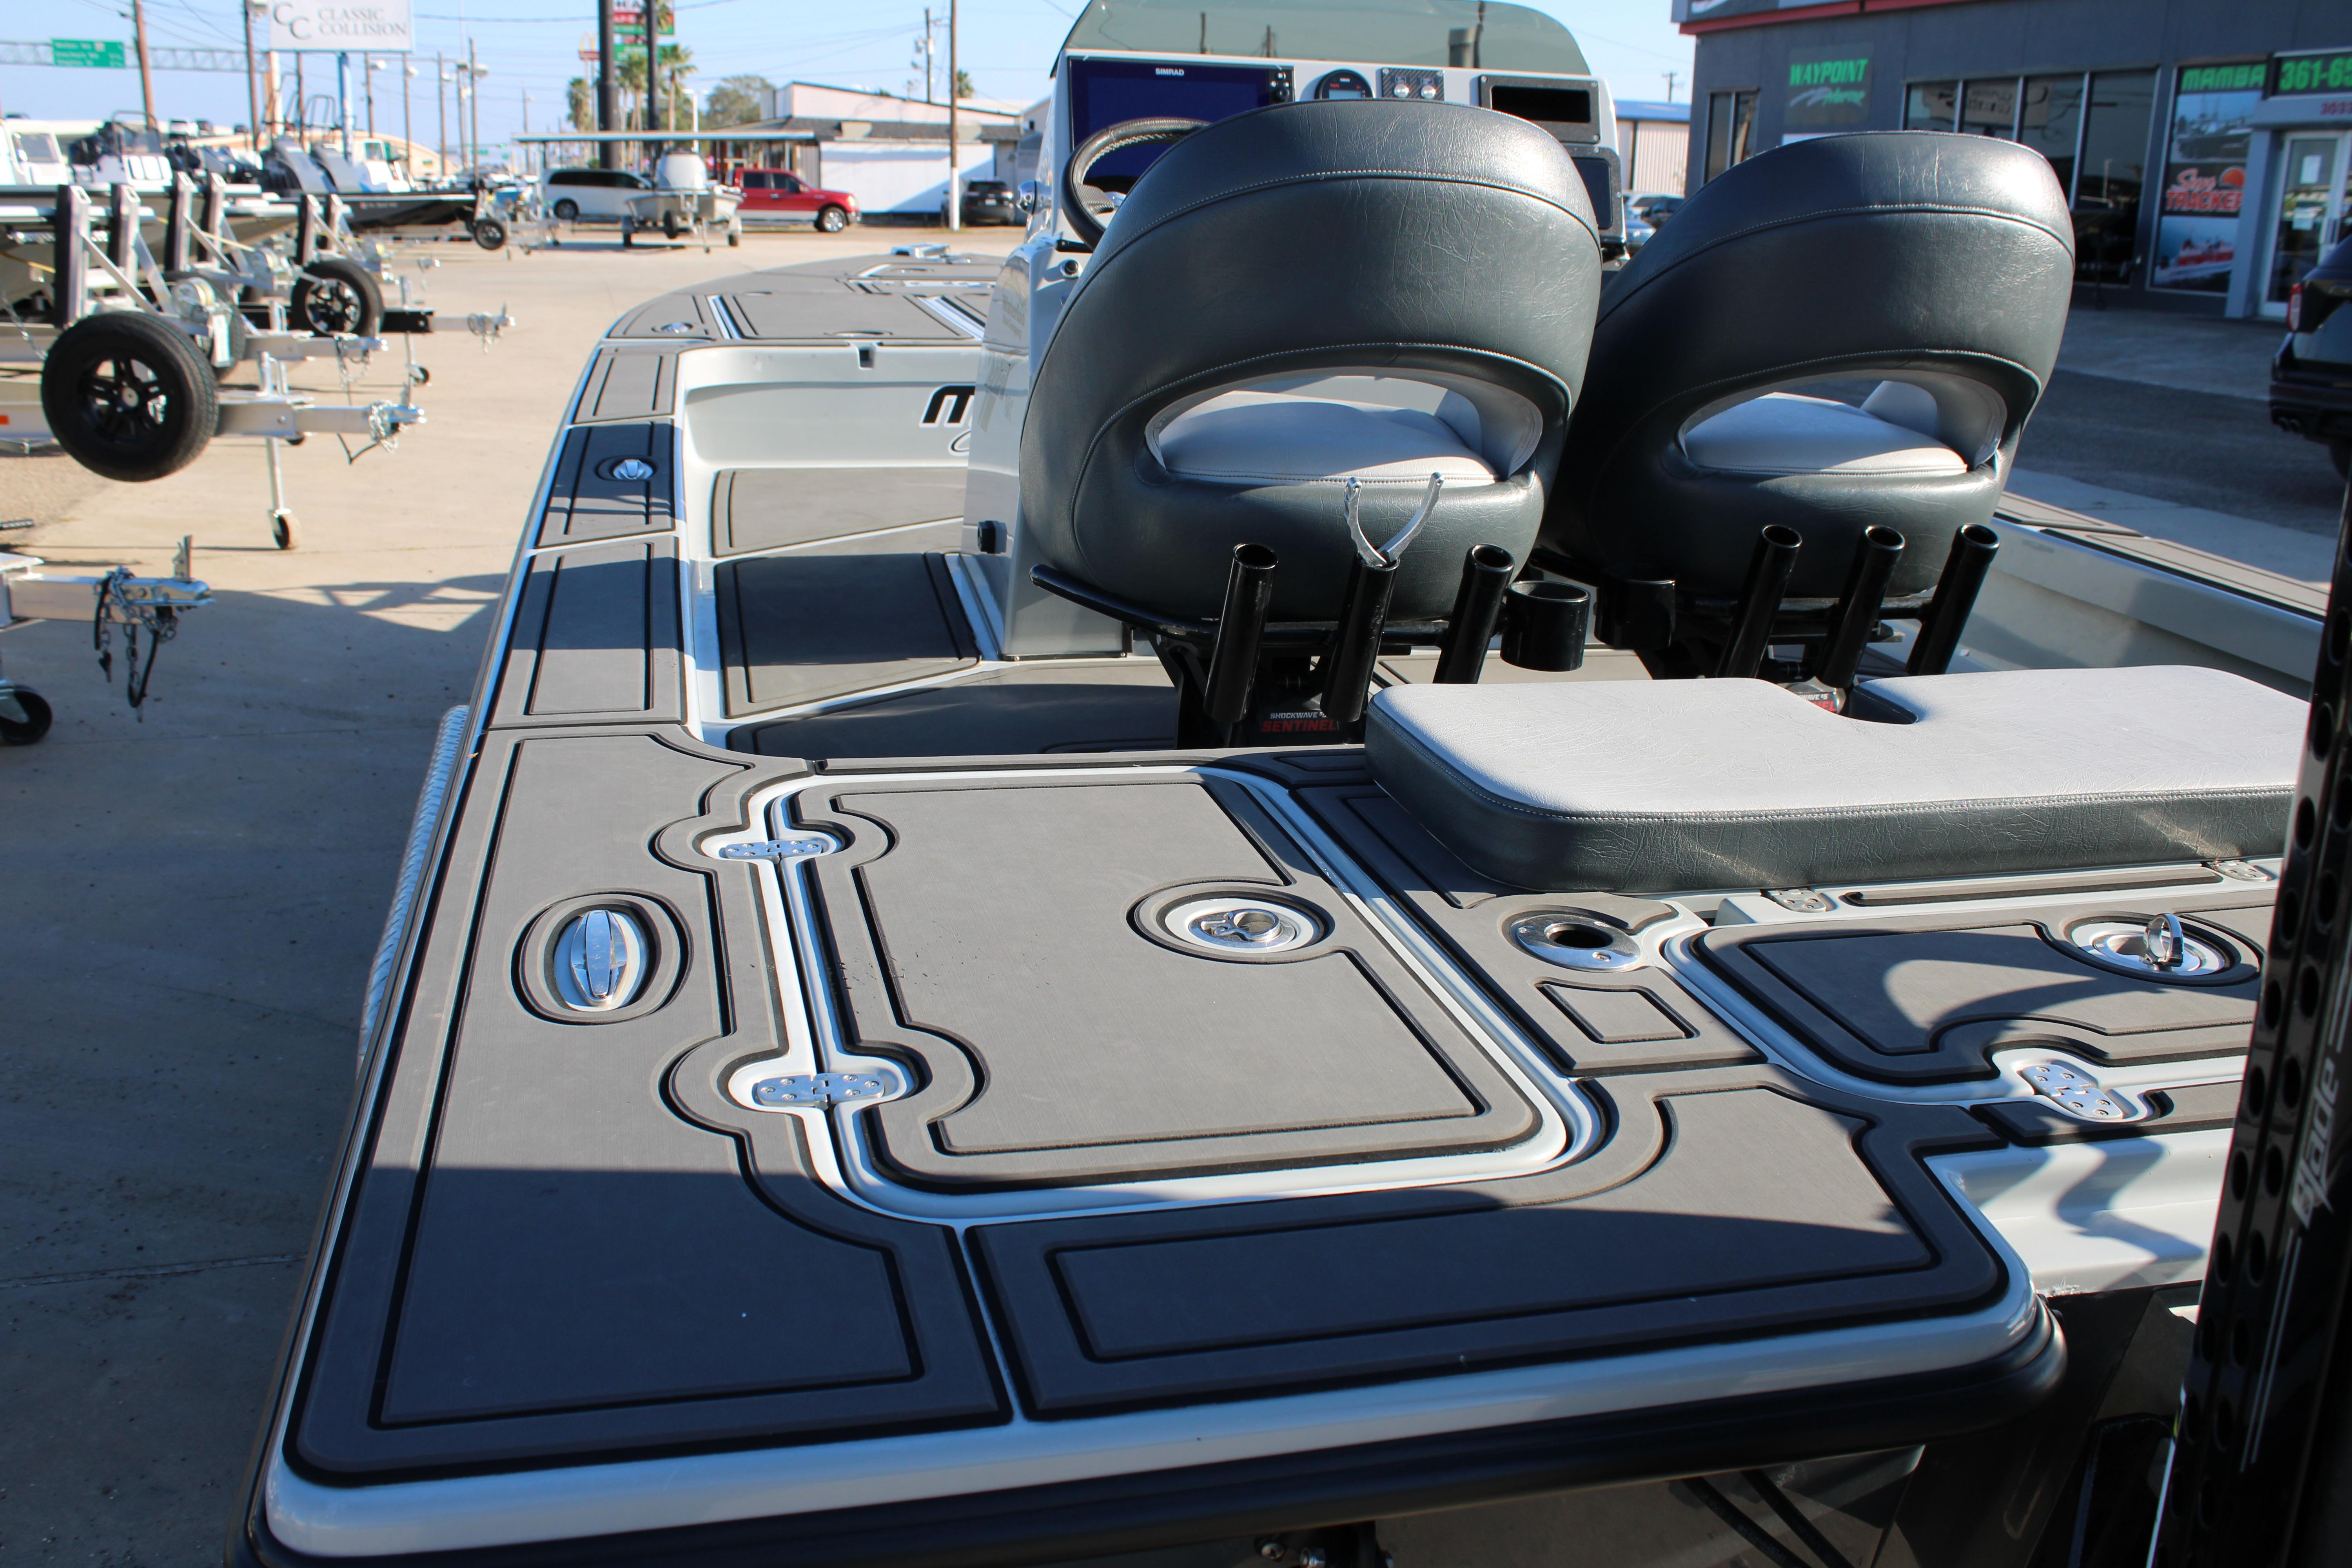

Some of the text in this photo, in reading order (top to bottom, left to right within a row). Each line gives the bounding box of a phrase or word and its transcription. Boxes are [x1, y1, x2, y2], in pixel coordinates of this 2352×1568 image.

[318, 8, 385, 22] CLASSIC
[318, 22, 408, 36] COLLISION
[1155, 67, 1185, 76] SIMRAD
[1788, 58, 1869, 86] WAYPOINT
[2181, 64, 2267, 91] MAMBA
[2171, 168, 2217, 192] Sun
[1262, 719, 1337, 732] SENTINEL
